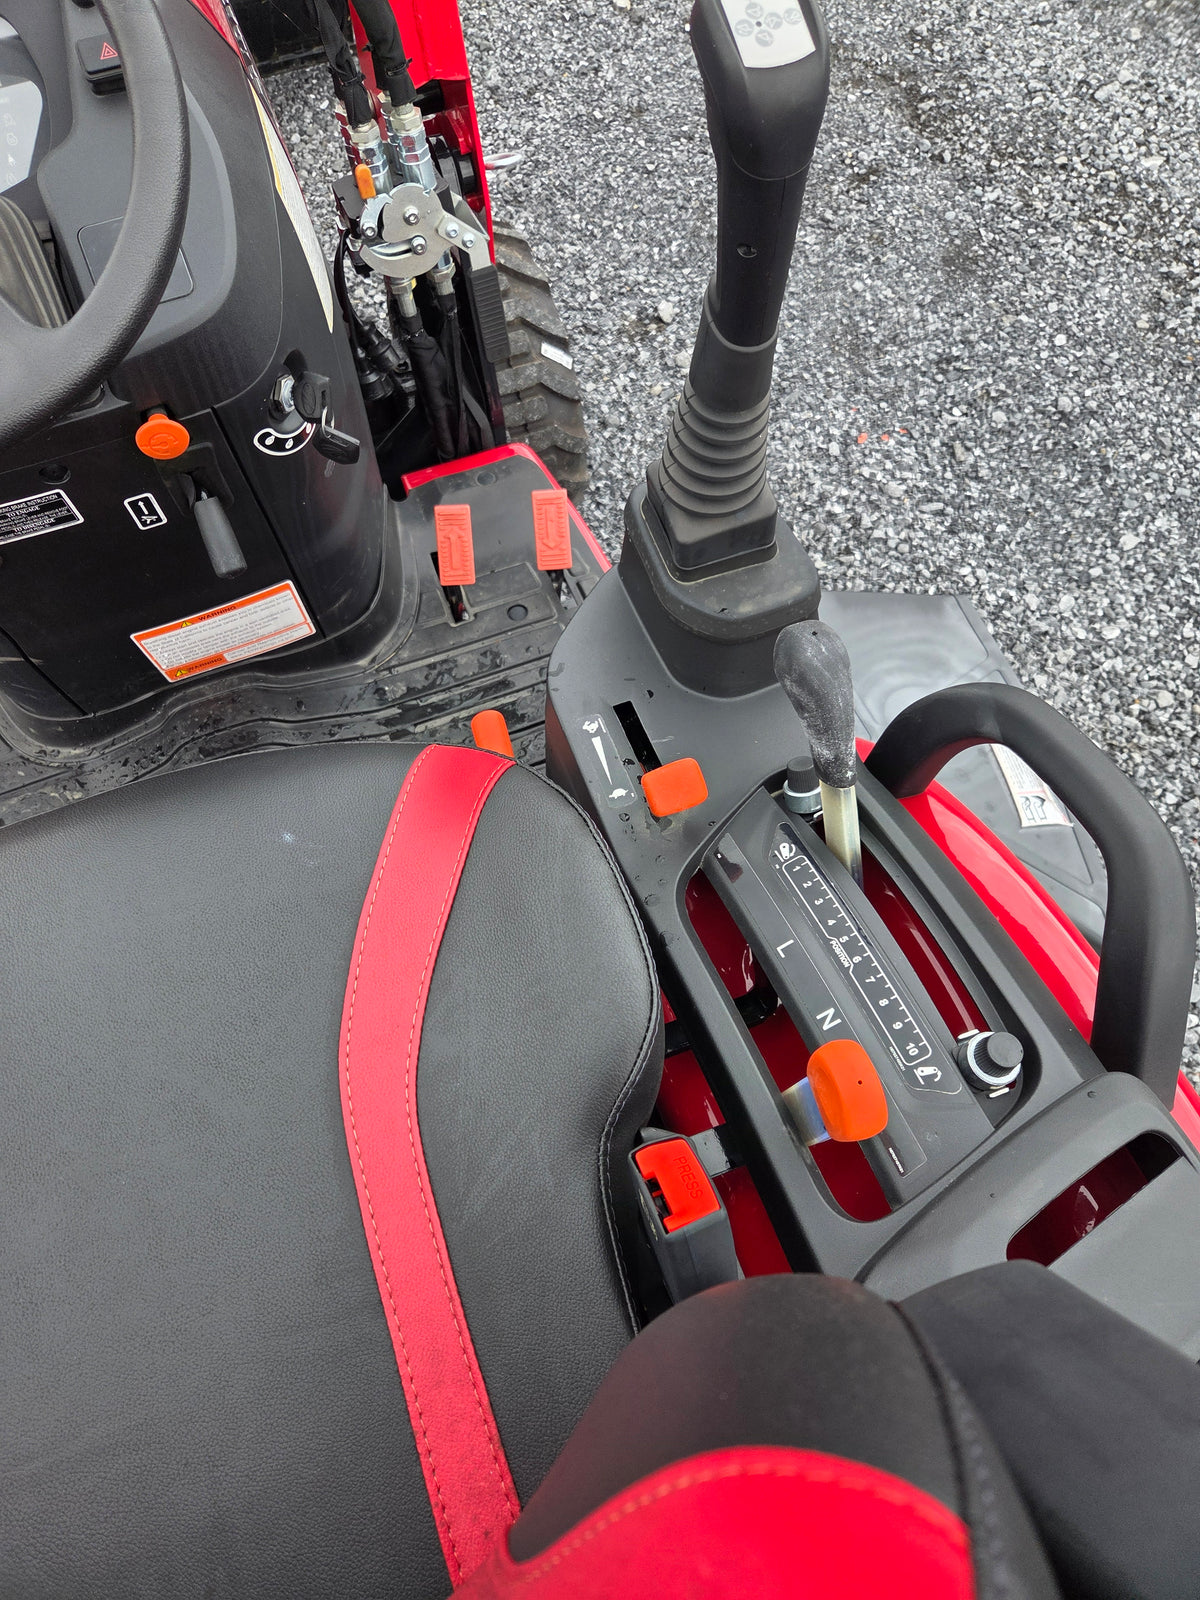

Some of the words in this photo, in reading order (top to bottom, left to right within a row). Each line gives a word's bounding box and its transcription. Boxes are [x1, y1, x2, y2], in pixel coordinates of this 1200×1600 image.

[26, 494, 58, 506] INSTRUCTION
[198, 605, 236, 621] WARNING
[187, 657, 223, 671] WARNING
[776, 939, 794, 958] L
[829, 940, 851, 968] POSITION
[802, 881, 812, 889] 2
[839, 935, 849, 943] 5
[852, 955, 862, 963] 6
[865, 975, 876, 983] 7
[878, 998, 889, 1007] 8
[892, 1021, 903, 1030] 9
[905, 1042, 919, 1056] 10
[816, 1007, 842, 1031] N
[673, 1155, 704, 1199] PRESS
